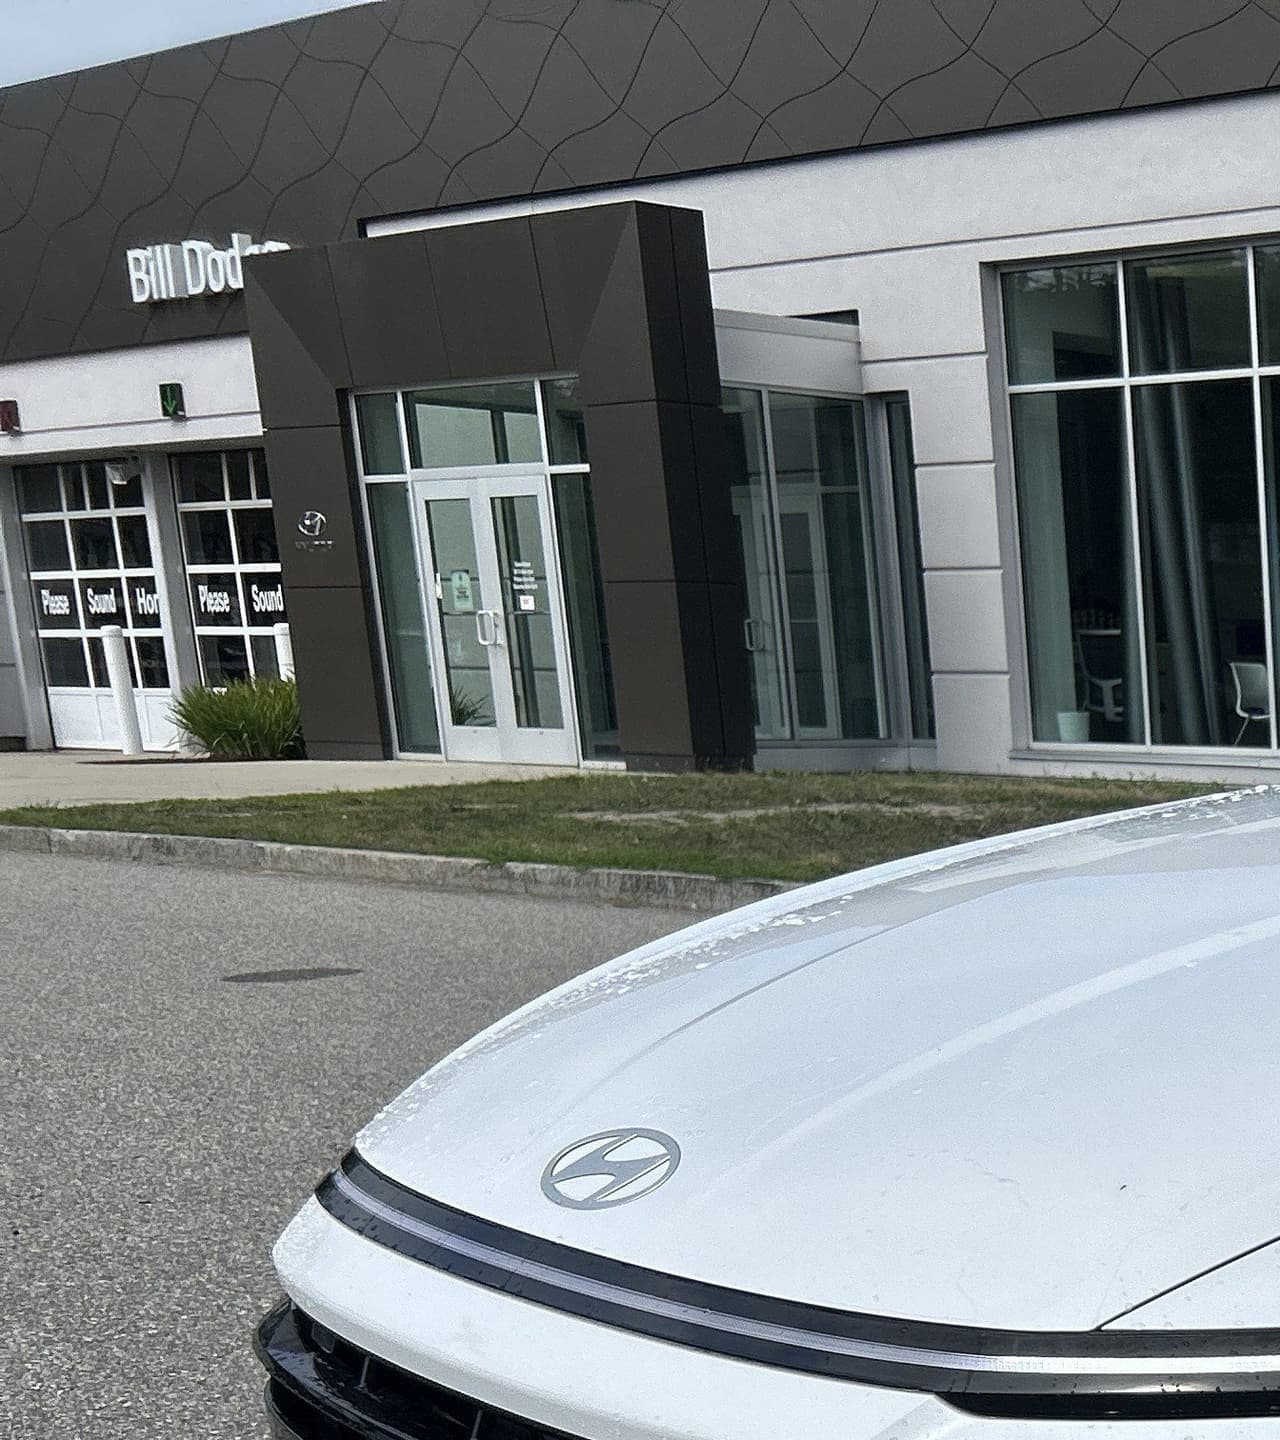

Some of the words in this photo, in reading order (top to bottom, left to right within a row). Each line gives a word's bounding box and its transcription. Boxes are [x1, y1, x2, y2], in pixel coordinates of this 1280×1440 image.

[126, 243, 177, 303] Bill
[181, 233, 291, 295] Dod
[40, 588, 71, 616] Please
[86, 587, 118, 615] Sound
[135, 587, 160, 616] Hor
[197, 584, 231, 614] Please
[251, 583, 285, 613] Sound
